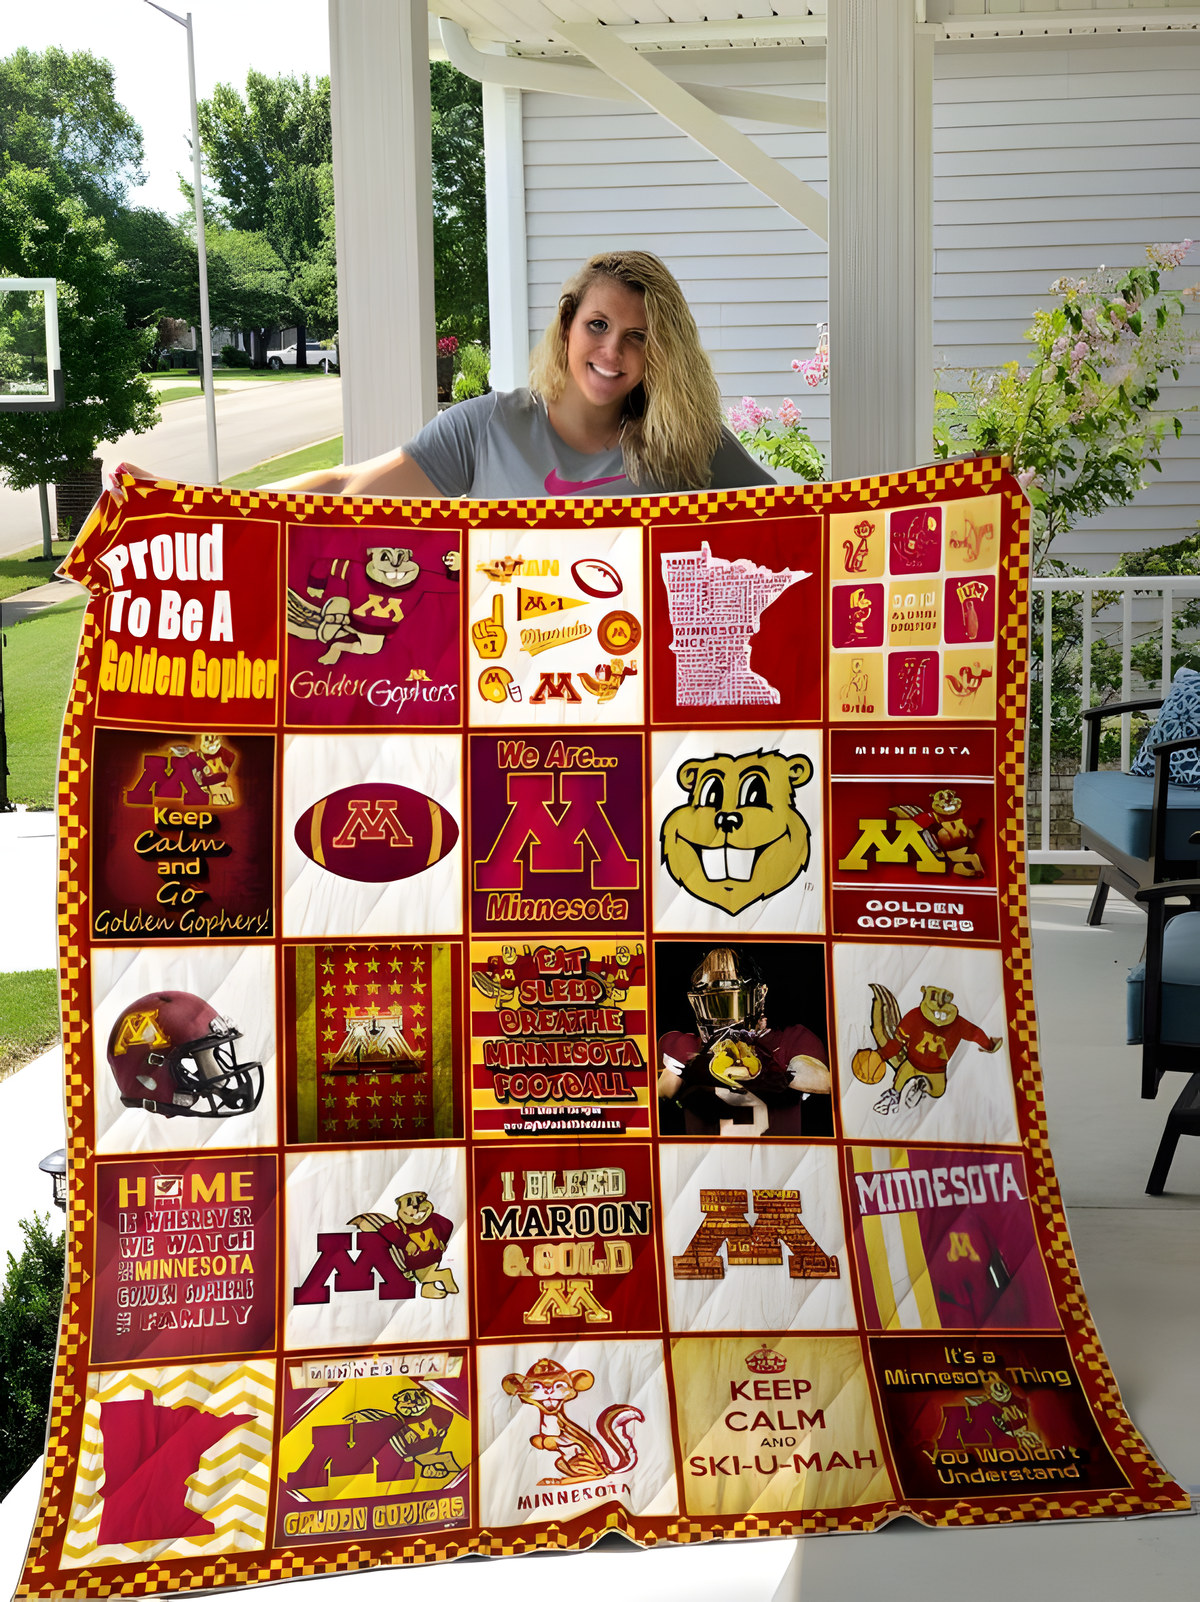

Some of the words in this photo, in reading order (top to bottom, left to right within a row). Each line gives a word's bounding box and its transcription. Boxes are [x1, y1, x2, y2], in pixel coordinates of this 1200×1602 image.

[100, 524, 224, 587] Proud
[109, 590, 151, 638] To
[157, 590, 204, 641] Be
[209, 590, 234, 642] A
[100, 639, 185, 697] Golden
[190, 649, 278, 704] Gopher
[529, 672, 582, 705] M
[497, 740, 540, 769] We
[544, 740, 618, 768] Are...
[154, 806, 213, 829] Keep
[333, 799, 414, 849] M
[474, 771, 640, 891] M
[133, 830, 226, 854] Calm
[838, 819, 946, 873] M
[157, 857, 201, 875] and
[156, 880, 204, 906] Go
[486, 892, 629, 921] Minnesota
[95, 908, 175, 935] Golden
[113, 1008, 171, 1057] M
[915, 1031, 949, 1062] M
[484, 1039, 643, 1069] MINNESOTA
[500, 1171, 516, 1202] I
[854, 1161, 1029, 1217] MINNESOTA
[144, 1206, 255, 1233] WHEREVER
[480, 1200, 652, 1240] MAROON
[672, 1188, 842, 1281] M
[946, 1231, 982, 1263] M
[135, 1253, 255, 1281] MINNESOTA
[293, 1232, 416, 1305] M
[522, 1279, 613, 1325] M
[944, 1346, 975, 1364] It's
[983, 1351, 997, 1364] a
[730, 1378, 812, 1402] KEEP
[1006, 1366, 1073, 1387] Thing
[725, 1408, 827, 1432] CALM
[760, 1435, 797, 1448] AND
[689, 1449, 879, 1477] SKI-U-MAH
[922, 1449, 970, 1465] You
[937, 1464, 1081, 1485] Understand
